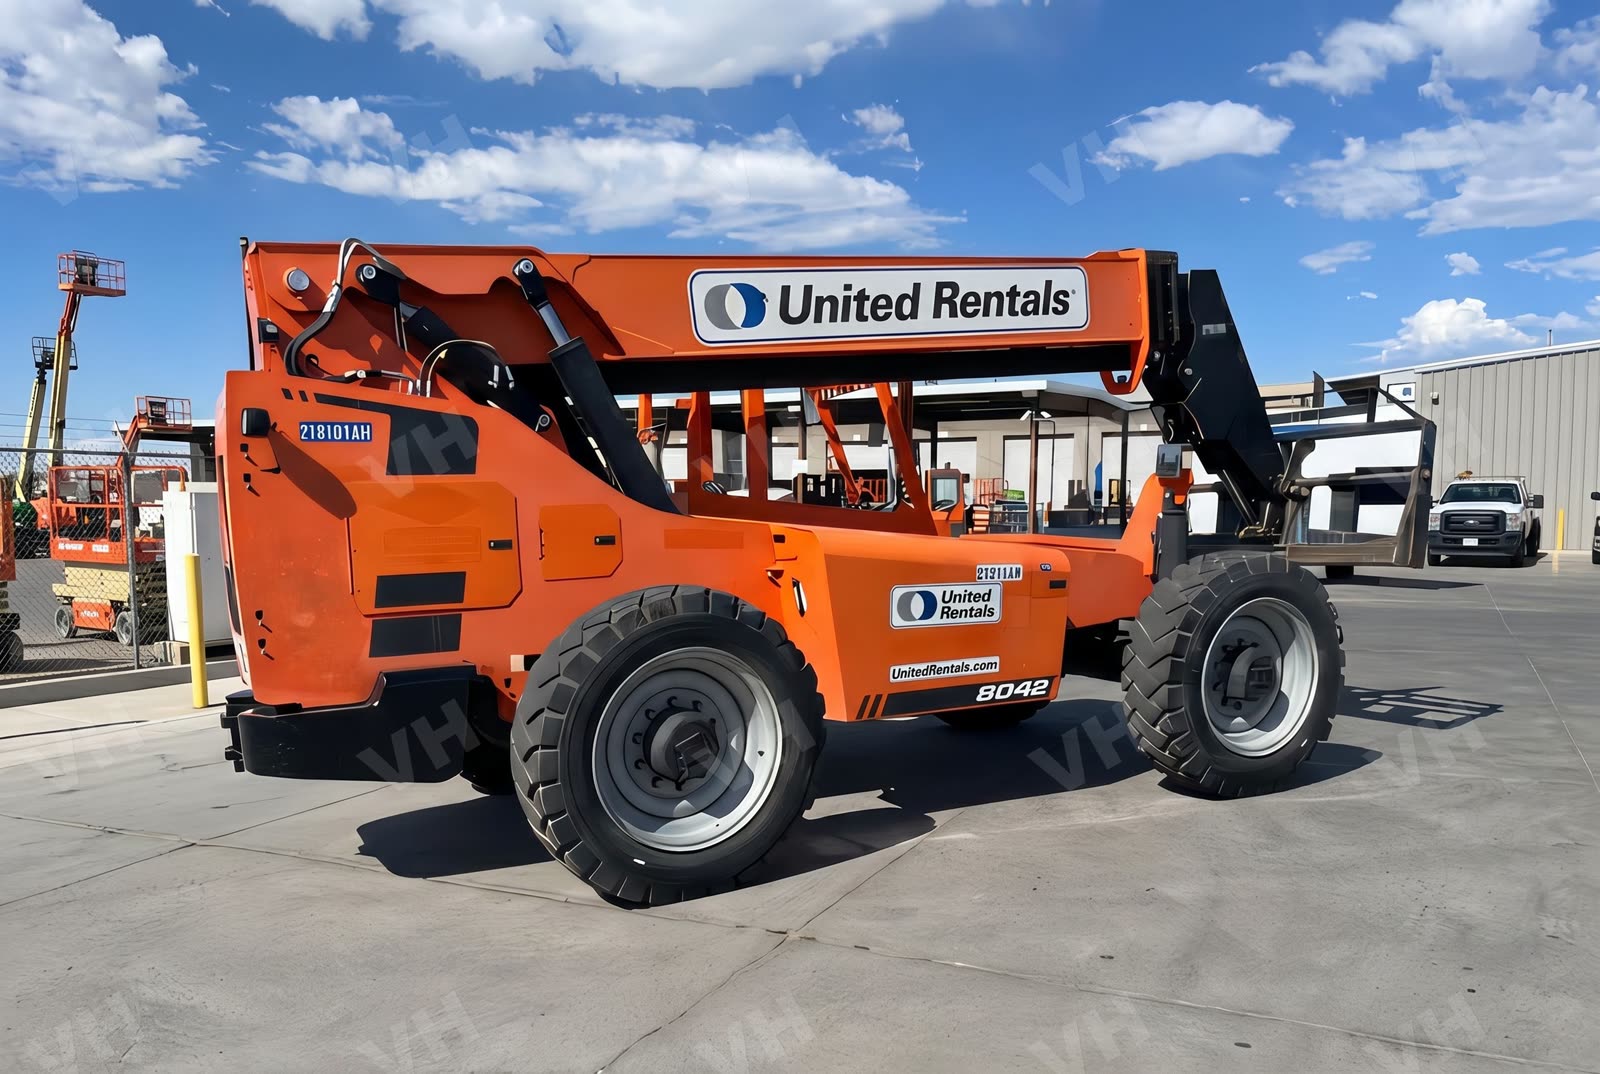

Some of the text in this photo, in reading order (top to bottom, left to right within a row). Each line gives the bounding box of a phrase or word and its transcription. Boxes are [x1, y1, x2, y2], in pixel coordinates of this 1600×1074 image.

[778, 279, 1071, 325] United Rentals
[300, 424, 371, 440] 218101AH
[941, 588, 992, 604] United
[940, 604, 995, 620] Rentals
[891, 660, 998, 680] UnitedRentals.com
[976, 679, 1049, 701] 8042
